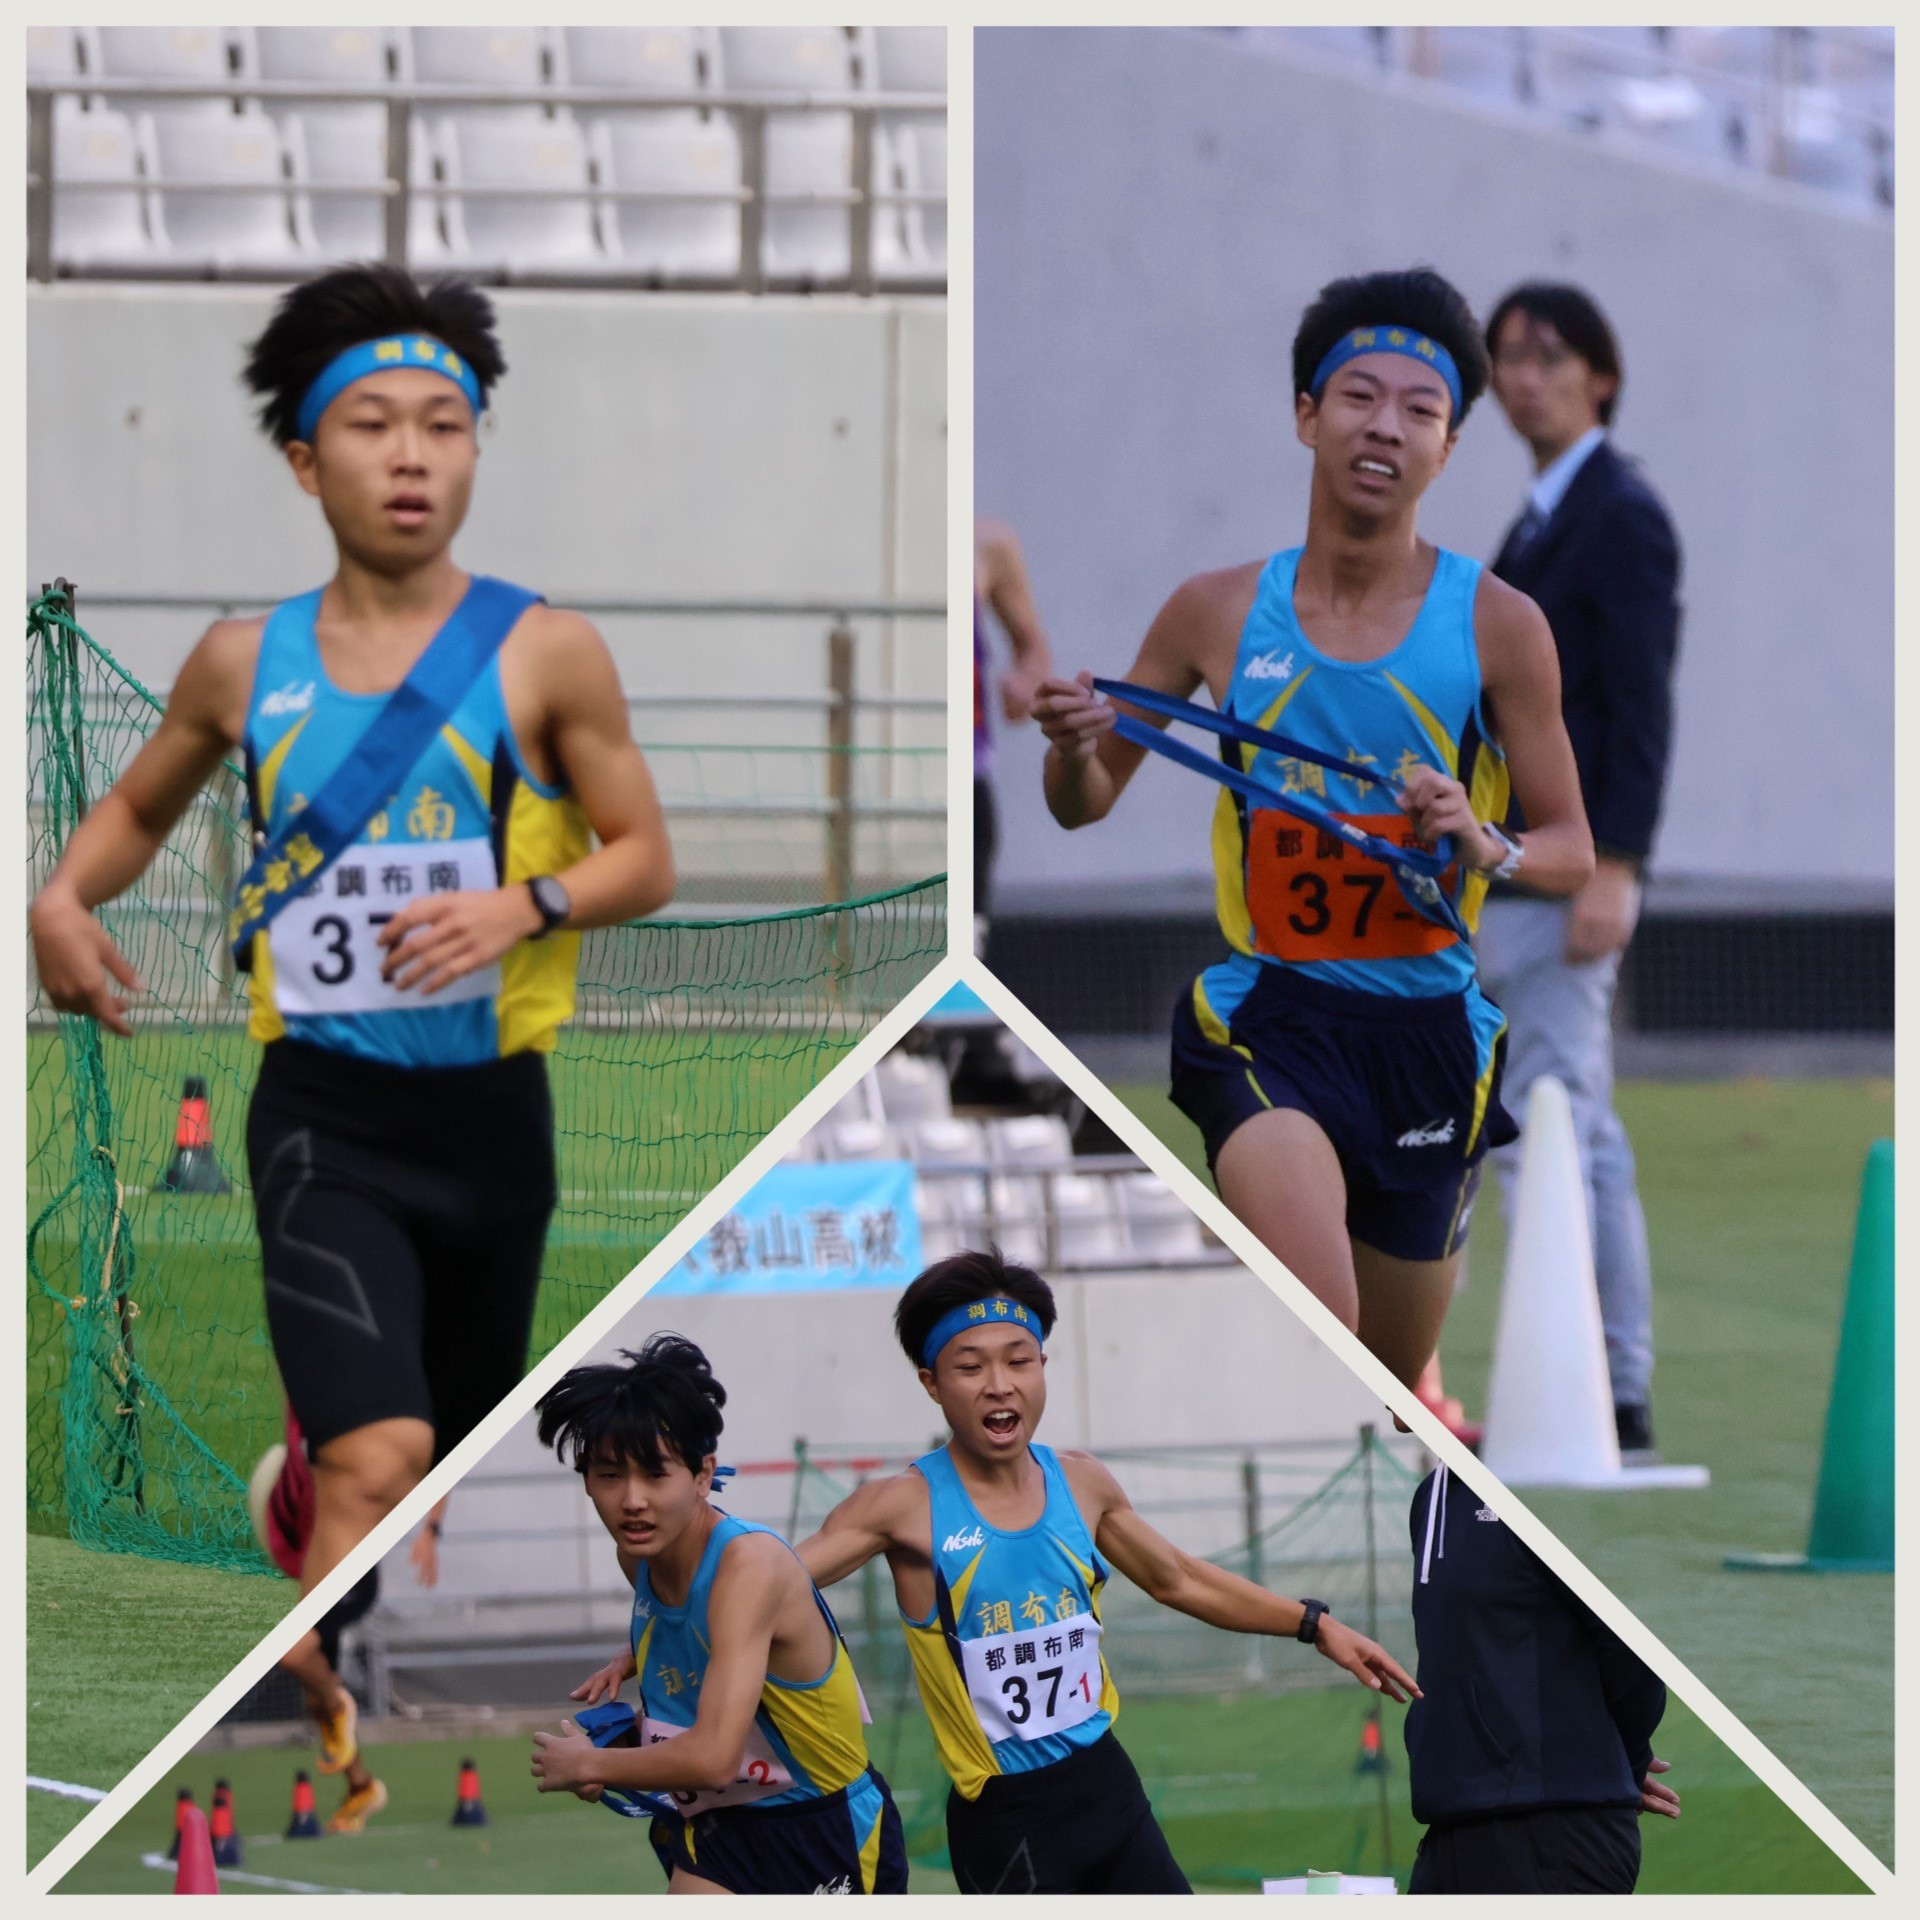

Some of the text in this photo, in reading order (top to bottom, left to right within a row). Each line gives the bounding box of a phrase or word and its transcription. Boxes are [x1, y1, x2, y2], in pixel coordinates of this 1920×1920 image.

[967, 1300, 1028, 1323] 調布南
[985, 1627, 1086, 1672] 都調布南
[1002, 1665, 1091, 1725] 37-1
